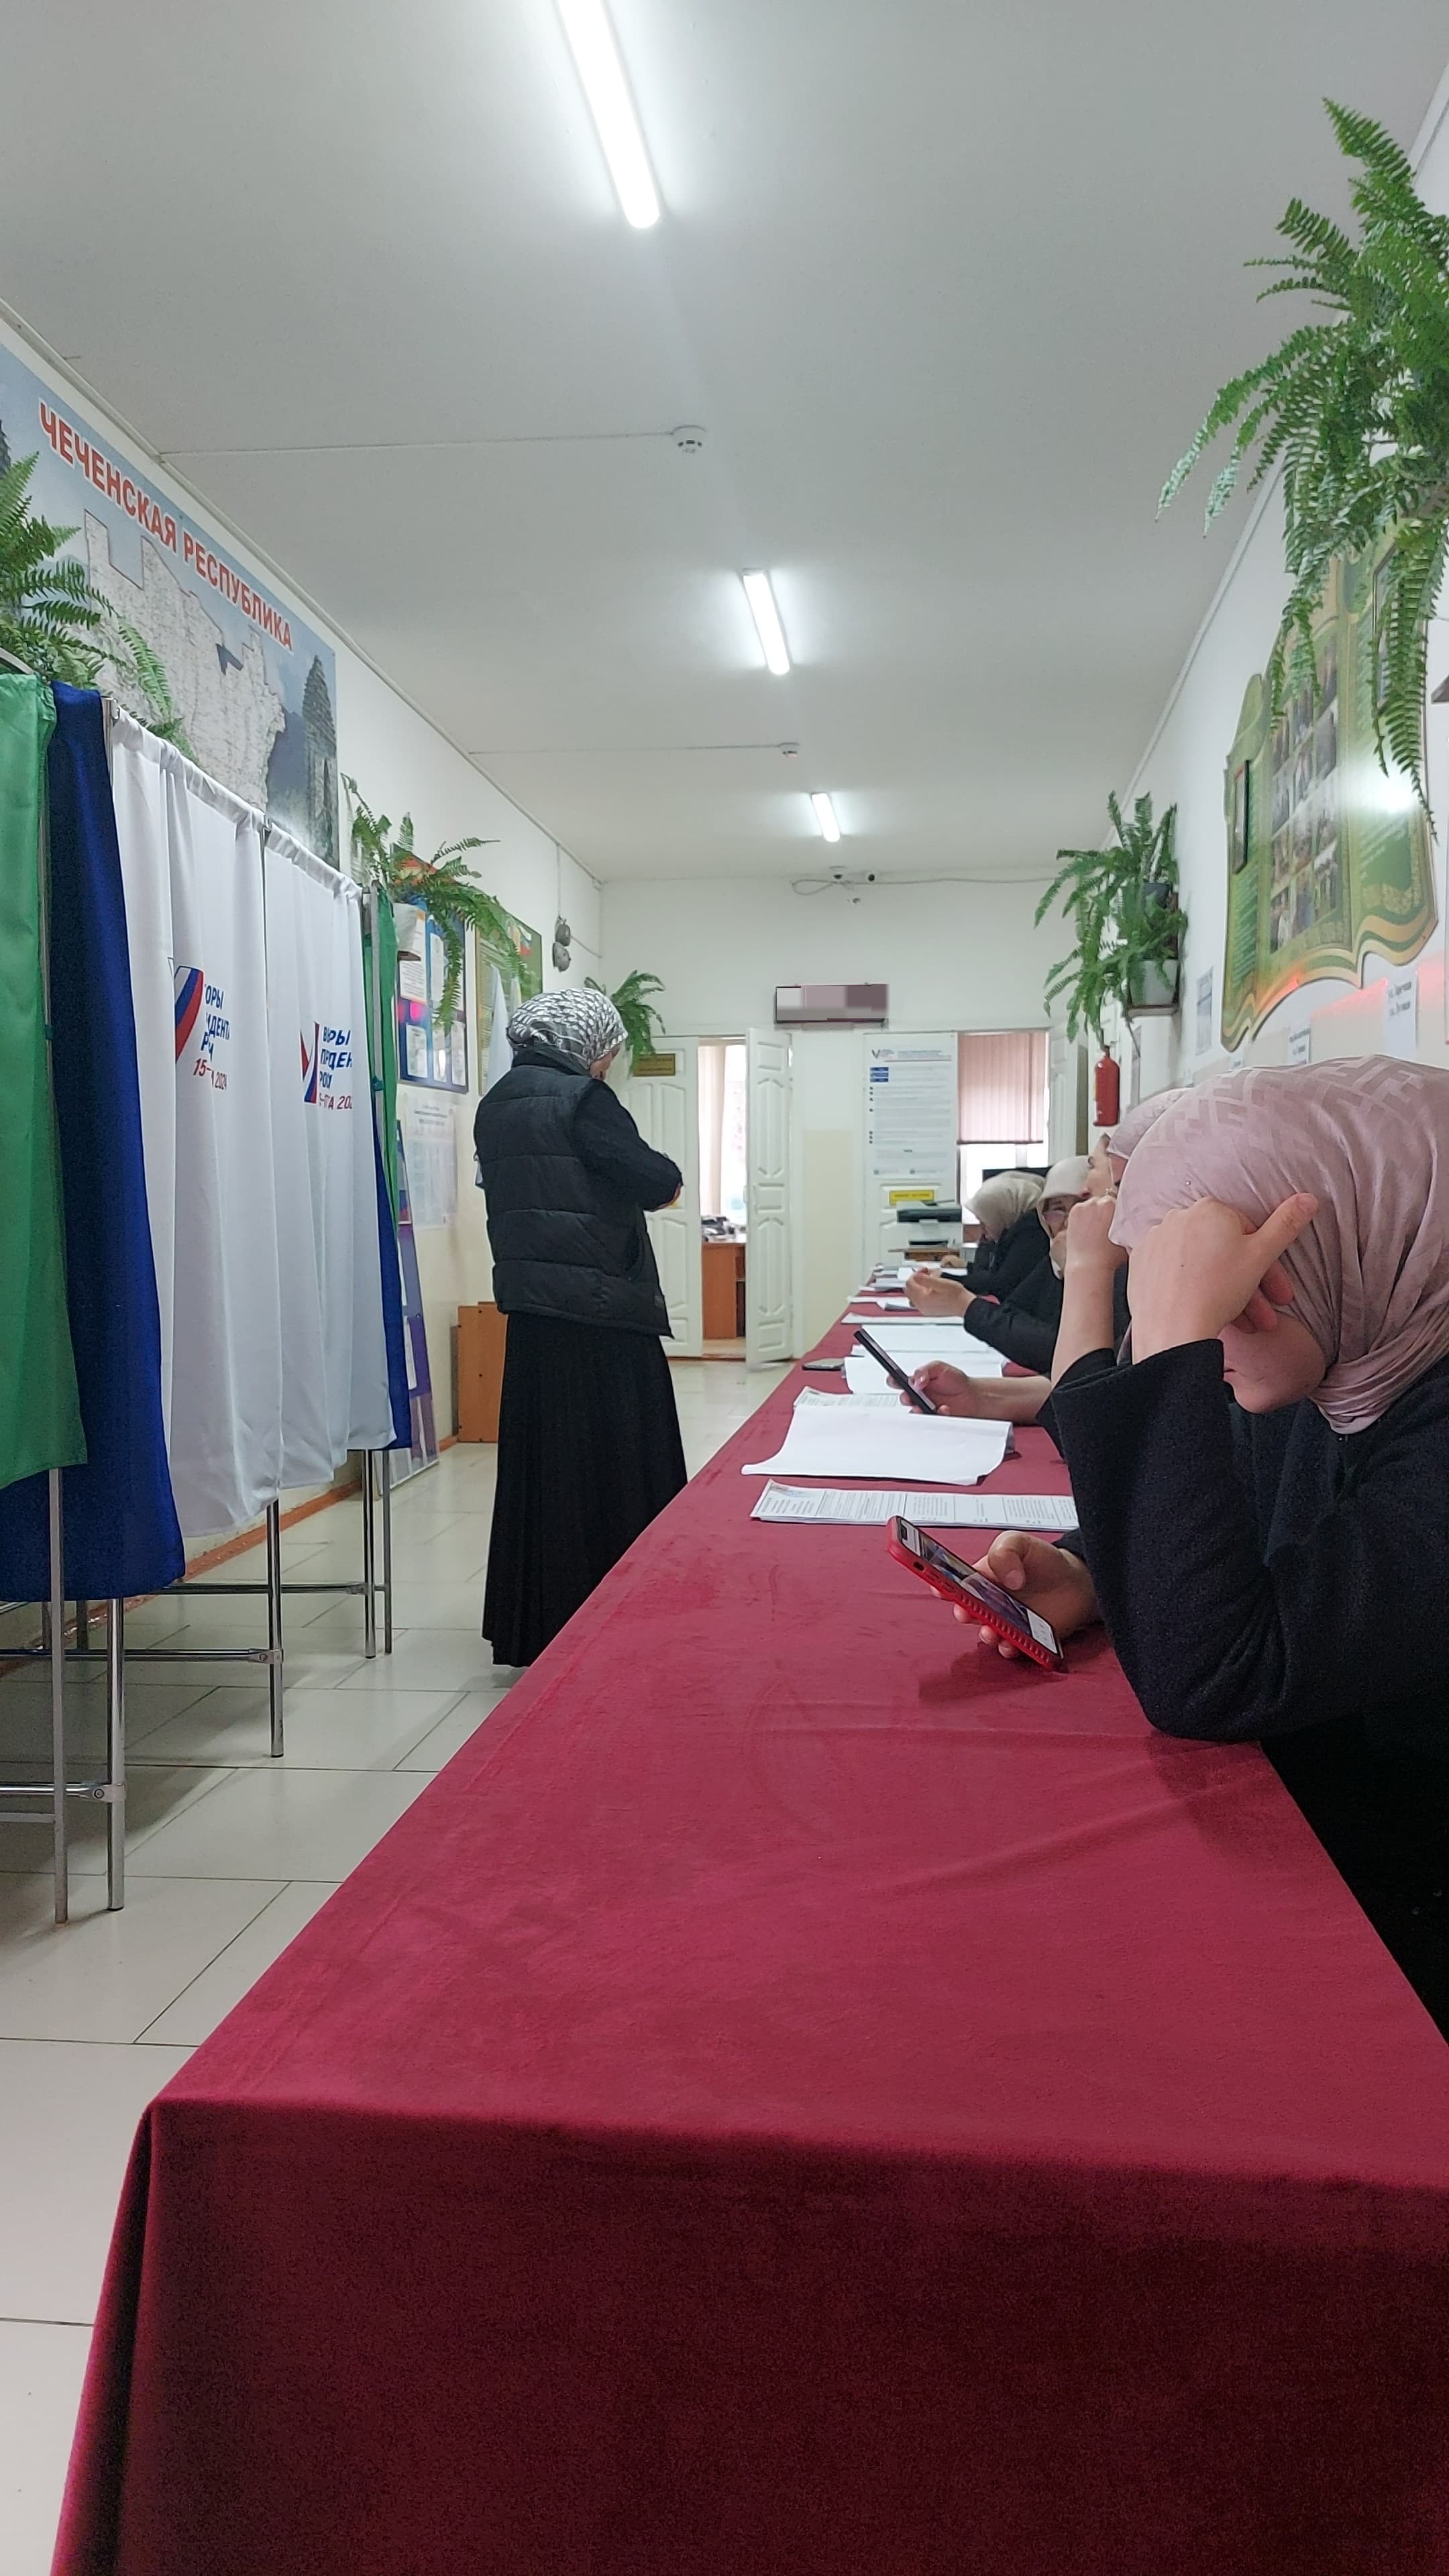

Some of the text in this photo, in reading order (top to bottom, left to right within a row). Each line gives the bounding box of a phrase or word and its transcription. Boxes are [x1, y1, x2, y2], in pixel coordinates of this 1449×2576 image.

[40, 401, 292, 651] ЧЕЧЕНСКАЯ РЕСПУБЛИКА
[205, 984, 224, 1010] ОРЫ
